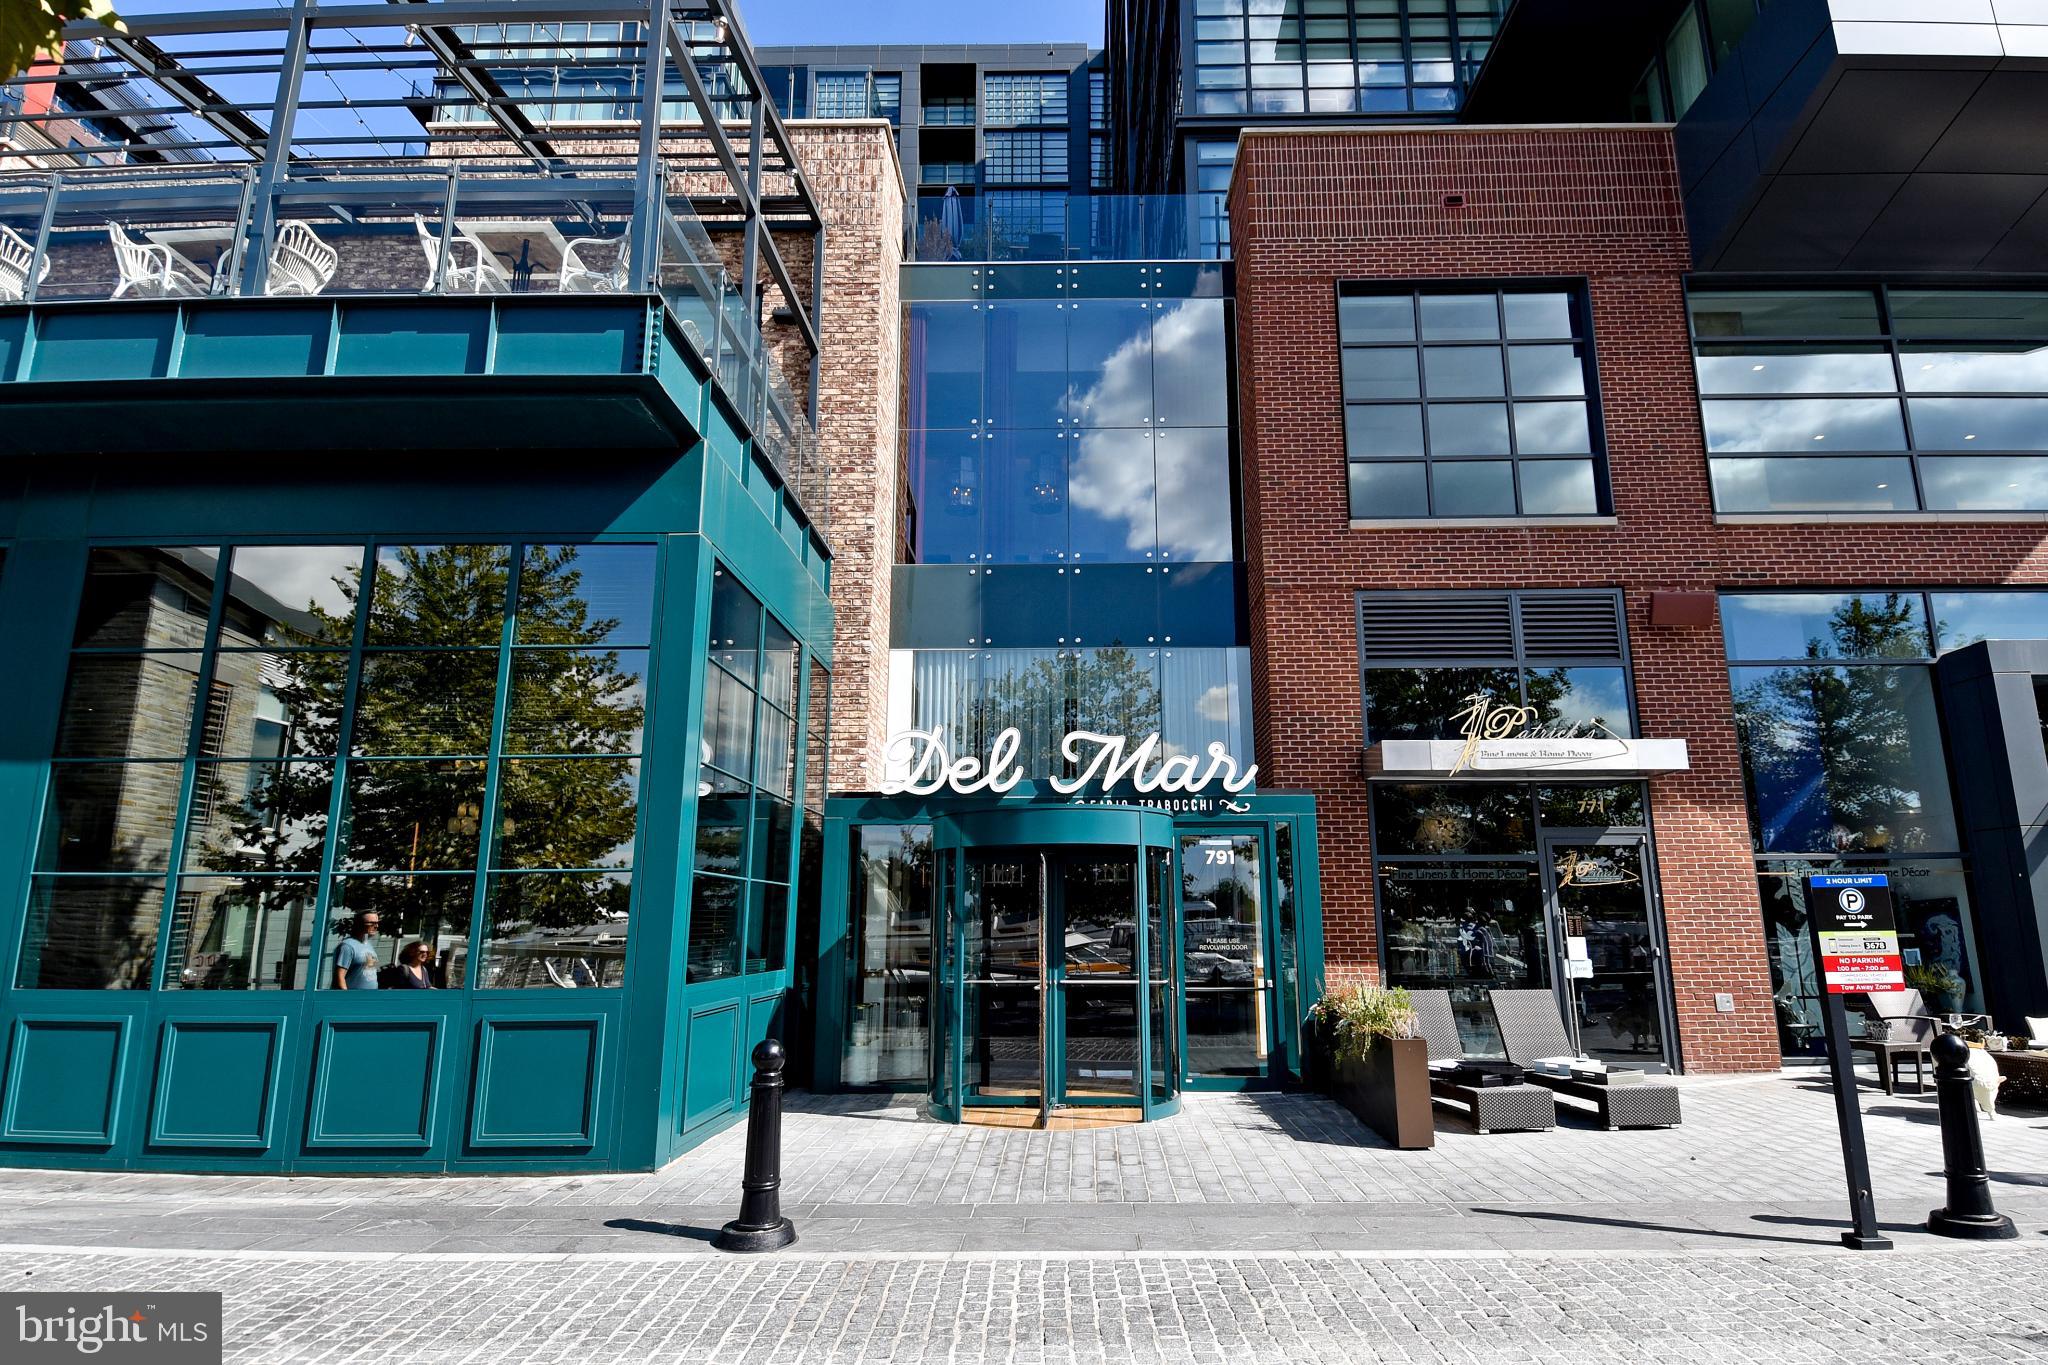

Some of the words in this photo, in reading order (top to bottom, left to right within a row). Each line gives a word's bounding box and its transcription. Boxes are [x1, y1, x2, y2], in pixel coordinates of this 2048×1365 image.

[878, 723, 1024, 796] Del
[1049, 729, 1259, 794] Mar
[1138, 799, 1213, 812] TRABOCCHI
[1577, 798, 1604, 814] 771
[1205, 850, 1235, 865] 791
[1391, 868, 1414, 880] Fine
[1416, 868, 1448, 880] Linens
[1450, 868, 1460, 879] &
[1462, 868, 1495, 879] Home
[1901, 867, 1931, 878] Décor
[1832, 877, 1853, 885] HOUR
[1846, 893, 1859, 909] P
[1838, 957, 1850, 965] NO
